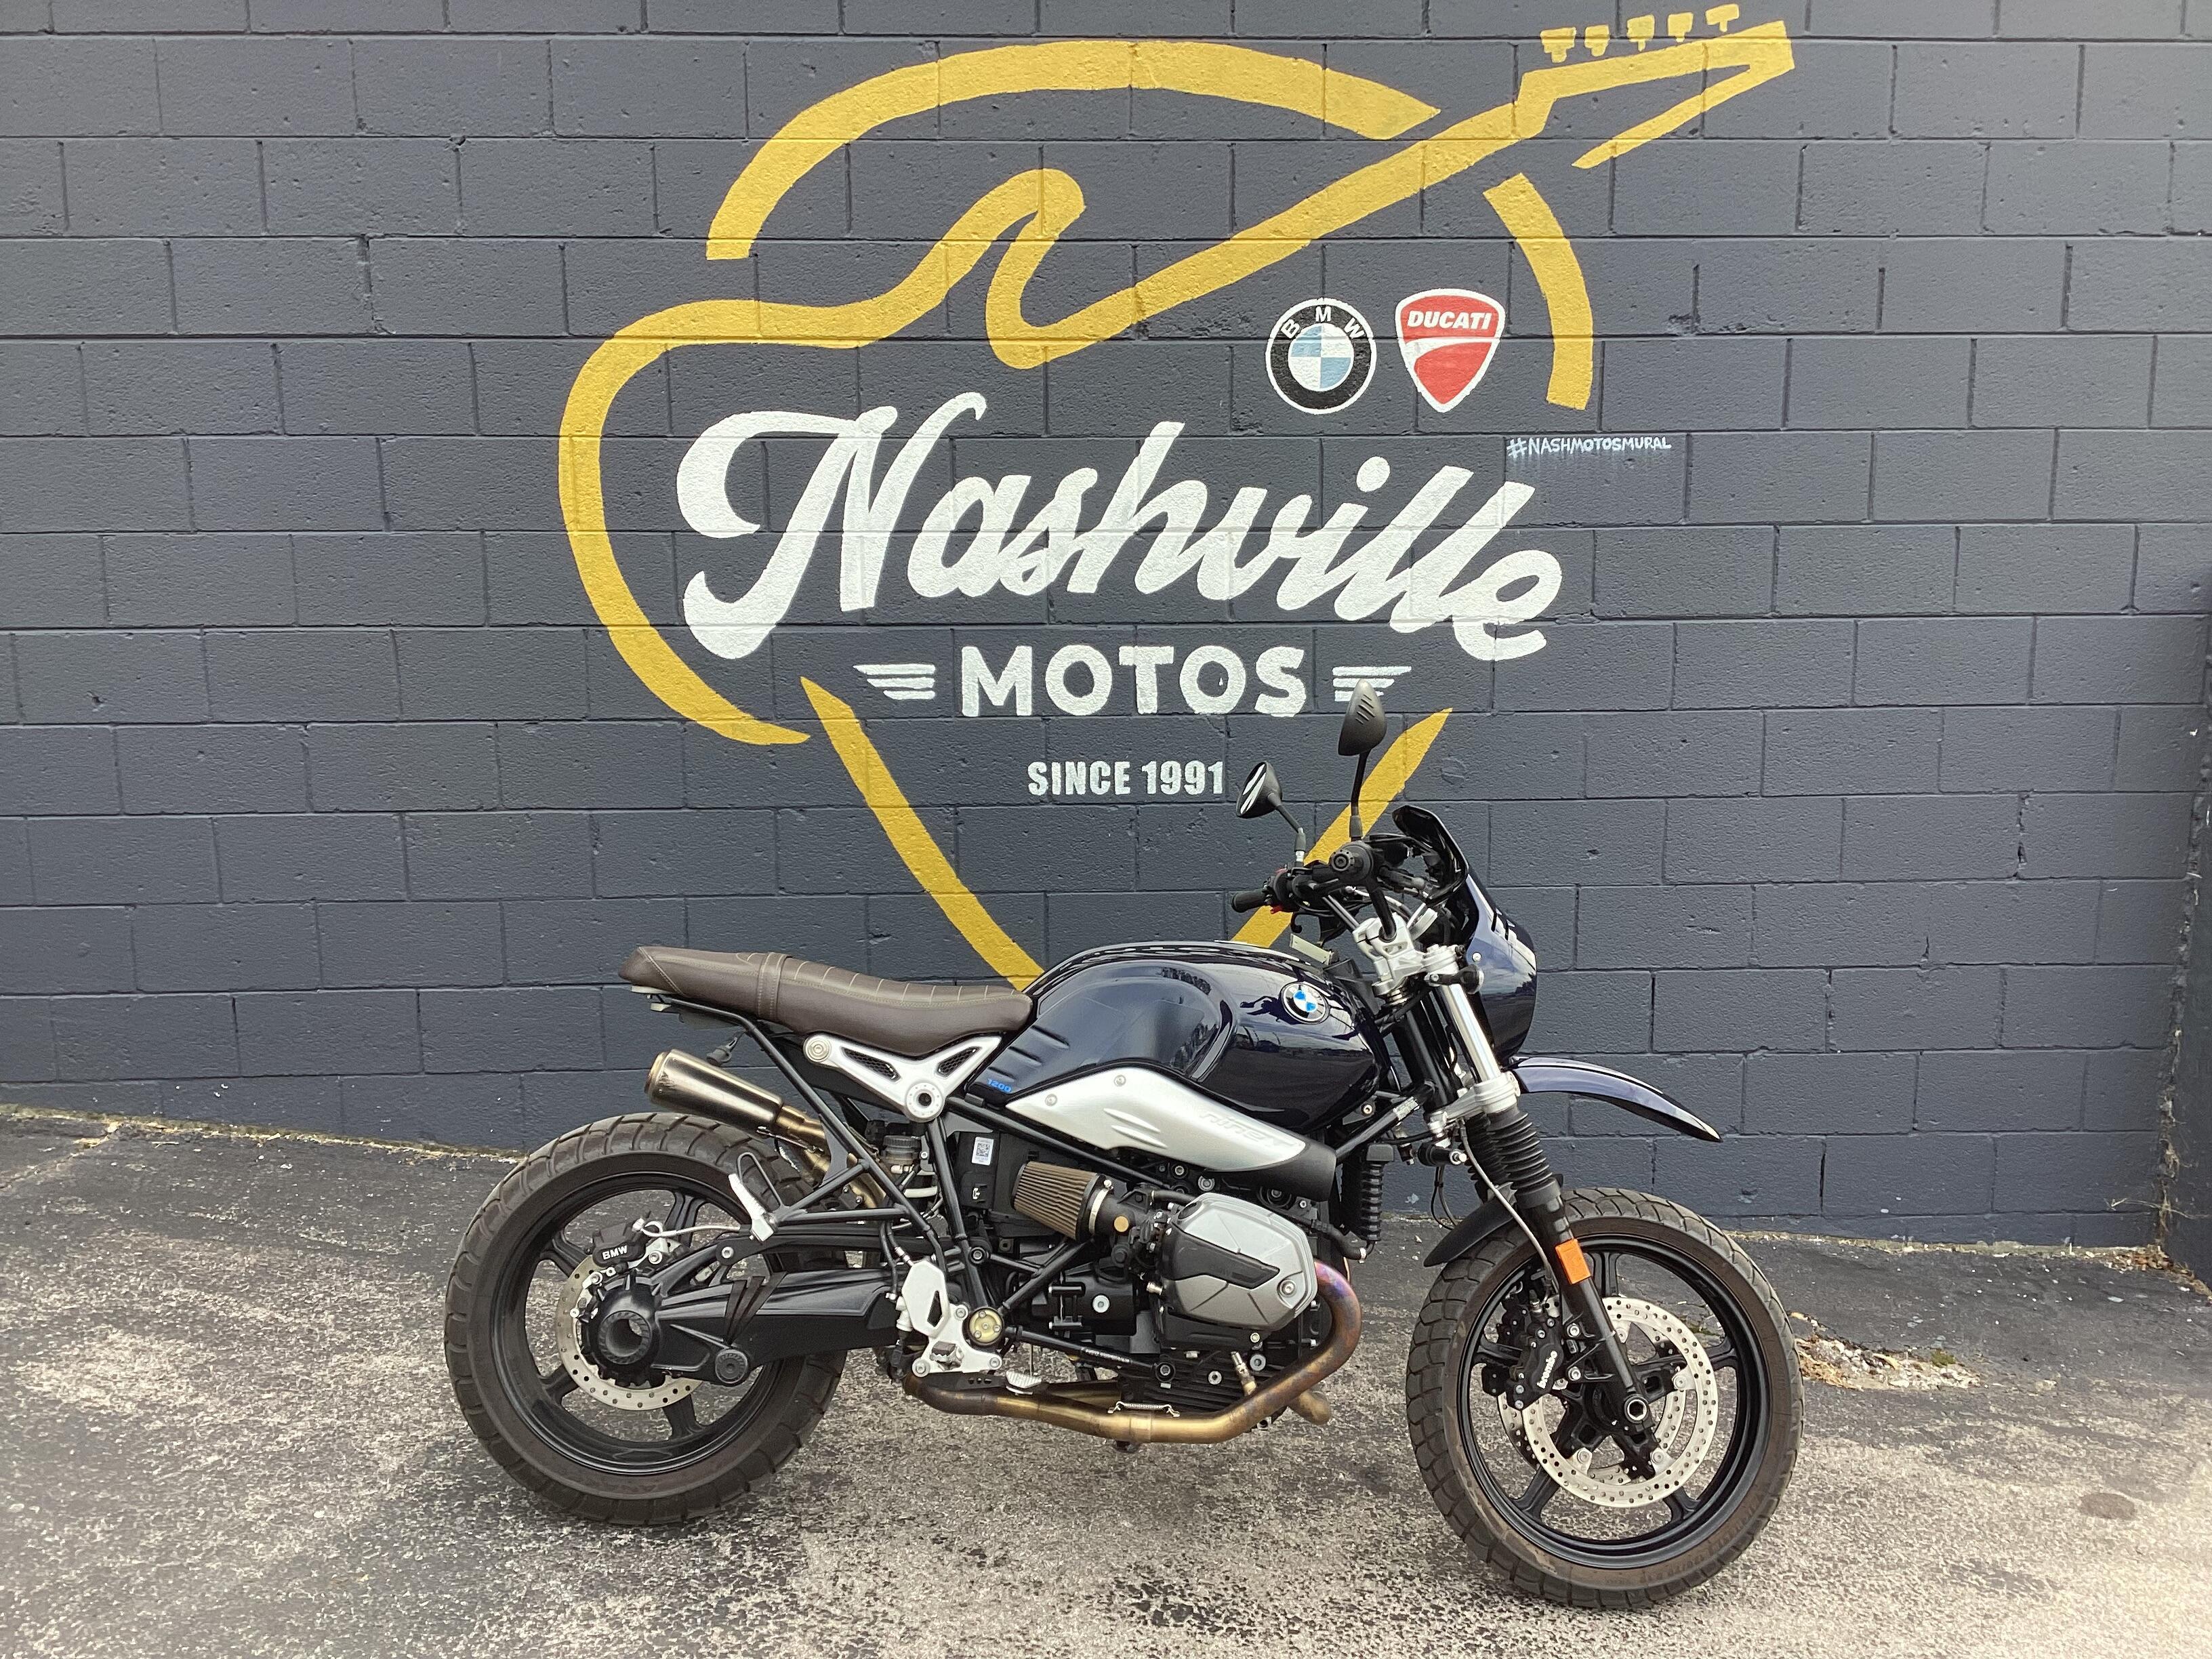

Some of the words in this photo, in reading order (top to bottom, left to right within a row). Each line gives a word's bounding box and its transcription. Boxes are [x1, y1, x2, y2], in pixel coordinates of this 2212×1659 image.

[1281, 306, 1365, 339] BMW
[1408, 310, 1492, 330] DUCATI
[1507, 436, 1672, 459] #NASHMOTOSMURAL
[677, 392, 1563, 661] Nashville
[960, 645, 1307, 717] MOTOS
[1027, 760, 1131, 796] SINCE
[1141, 760, 1224, 796] 1991
[987, 1078, 1012, 1092] 1200
[602, 1245, 628, 1260] BMW
